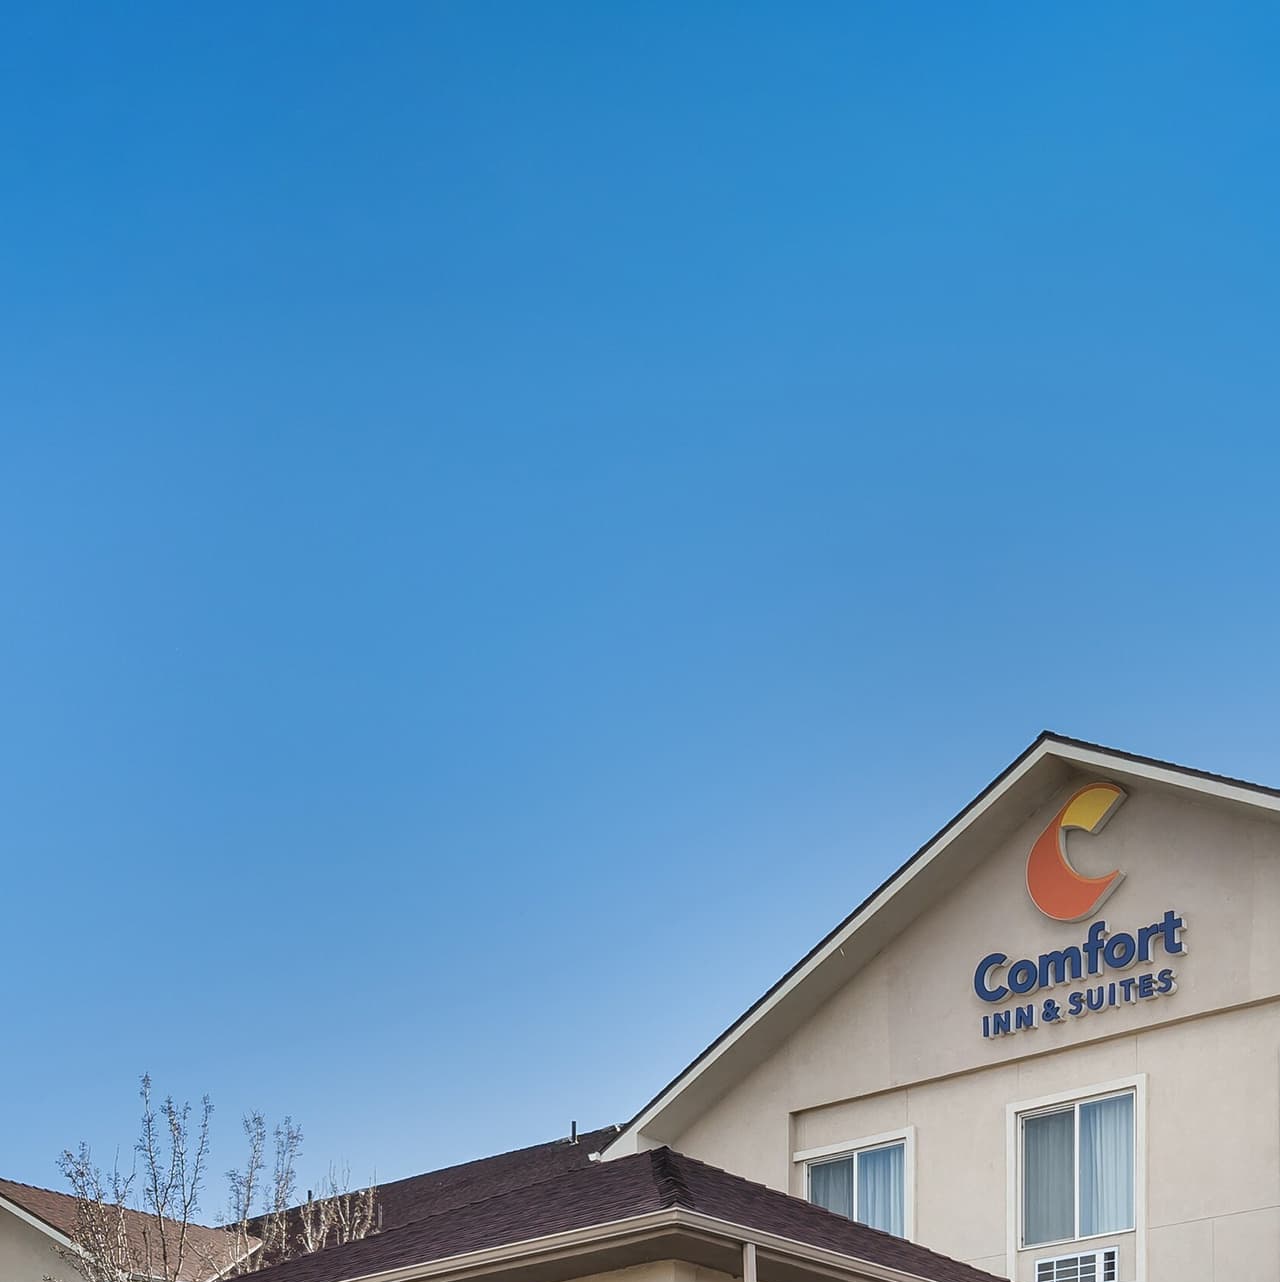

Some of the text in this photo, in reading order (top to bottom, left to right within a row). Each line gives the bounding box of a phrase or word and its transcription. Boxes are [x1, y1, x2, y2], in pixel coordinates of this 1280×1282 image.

[973, 909, 1186, 1003] Comfort
[982, 968, 1176, 1039] INN & SUITES
